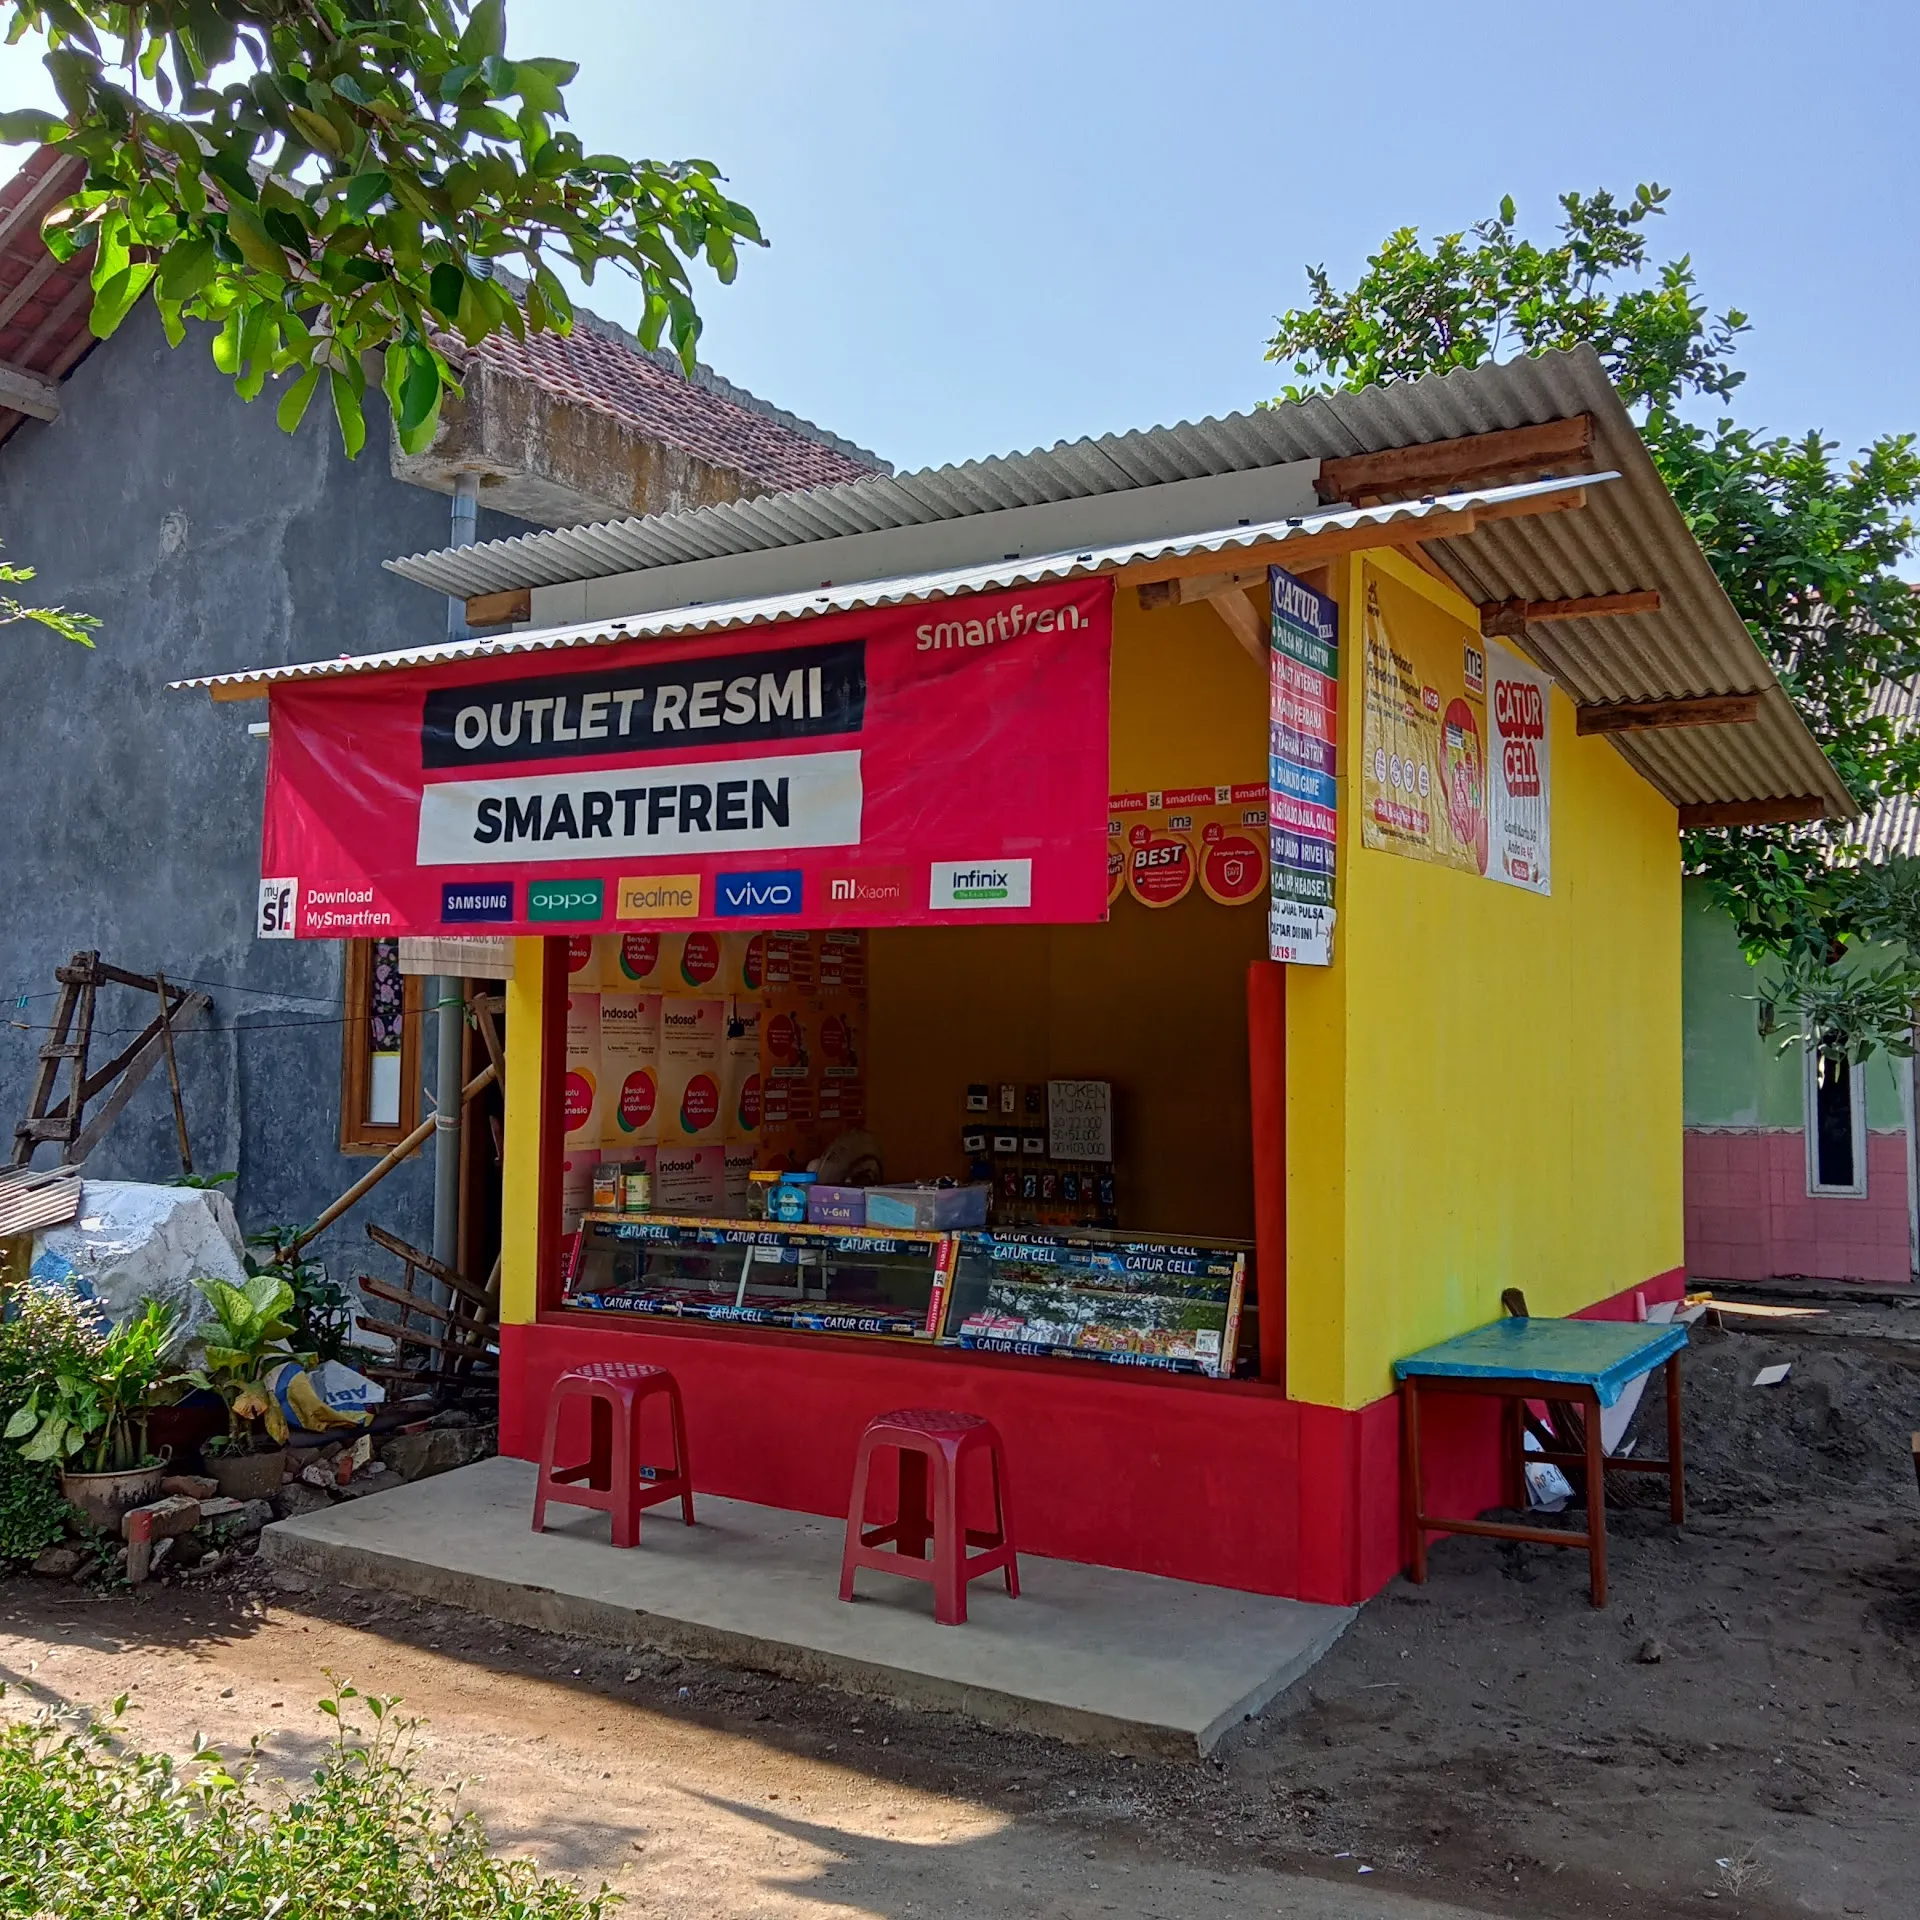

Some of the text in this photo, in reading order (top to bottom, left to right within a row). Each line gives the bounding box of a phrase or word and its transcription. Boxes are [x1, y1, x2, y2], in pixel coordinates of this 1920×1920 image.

[1275, 576, 1320, 628] CATUR
[1464, 637, 1483, 680] im3
[454, 666, 823, 750] OUTLET RESMI
[1496, 687, 1541, 726] CATUR
[1505, 746, 1538, 783] CELL
[1300, 775, 1320, 796] GAME
[473, 777, 790, 844] SMARTFREN
[1242, 811, 1267, 823] im3
[1168, 816, 1192, 828] im3
[1135, 845, 1184, 868] BEST
[953, 869, 1008, 888] Infinix
[307, 887, 373, 904] Download
[624, 885, 693, 909] realme
[857, 883, 900, 899] Xiaomi
[447, 893, 507, 911] SAMSUNG
[306, 910, 391, 929] MySmartfren
[1298, 906, 1324, 920] PULSA
[602, 1006, 638, 1019] indosat
[664, 1013, 697, 1025] indosat
[1053, 1082, 1106, 1099] TOKEN
[1051, 1098, 1107, 1113] MURAH
[660, 1160, 694, 1172] indosat
[725, 1156, 753, 1168] indosat
[620, 1225, 669, 1239] CATUR CELL
[726, 1230, 756, 1243] CATUR
[758, 1233, 779, 1245] CELL
[840, 1238, 871, 1251] CATUR
[873, 1240, 896, 1252] CELL
[993, 1245, 1028, 1260] CATUR
[1031, 1248, 1056, 1262] CELL
[1126, 1256, 1163, 1272] CATUR
[1167, 1259, 1196, 1274] CELL
[604, 1296, 655, 1312] CATUR CELL
[709, 1307, 763, 1322] CATUR CELL
[824, 1316, 882, 1332] CATUR CELL
[976, 1338, 1011, 1353] CATUR
[1014, 1342, 1041, 1356] CELL
